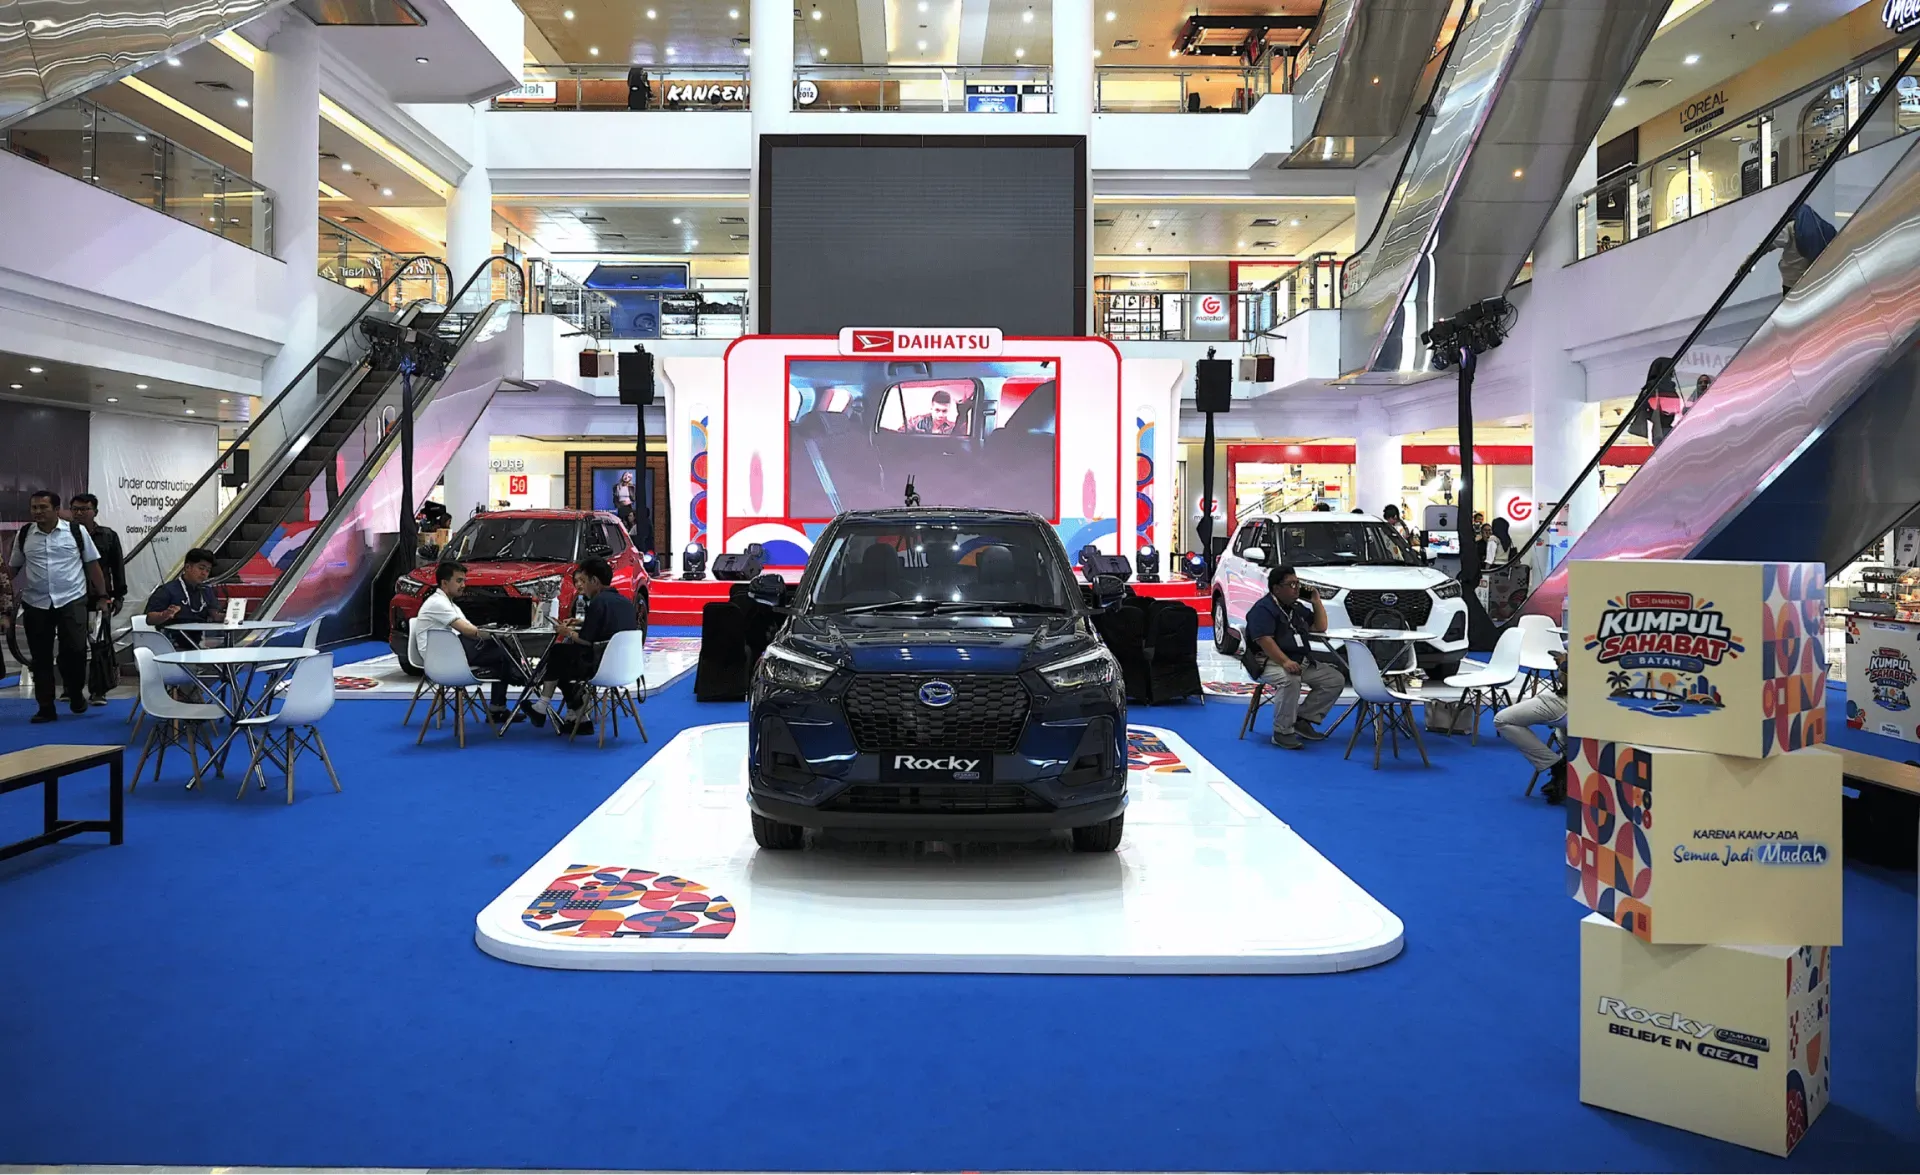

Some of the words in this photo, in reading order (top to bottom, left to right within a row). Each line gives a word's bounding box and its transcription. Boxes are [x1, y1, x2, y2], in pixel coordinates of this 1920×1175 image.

[1680, 90, 1728, 124] L'ORÉAL
[1694, 121, 1713, 134] PARIS
[898, 335, 990, 349] DAIHATSU
[118, 477, 144, 489] Under
[145, 480, 194, 491] construction
[512, 478, 526, 492] 50
[131, 495, 164, 510] Opening
[1600, 611, 1728, 638] KUMPUL
[1601, 633, 1728, 662] SAHABAT
[1638, 656, 1682, 667] BATAM
[1870, 657, 1911, 673] KUMPUL
[1871, 668, 1912, 685] SAHABAT
[894, 755, 980, 772] Rocky
[1693, 830, 1736, 839] KARENA
[1776, 831, 1799, 840] ADA
[1673, 845, 1720, 863] Semua
[1722, 845, 1753, 866] Jadi
[1760, 842, 1824, 863] Mudah
[1598, 996, 1716, 1039] Rocky
[1609, 1023, 1672, 1047] BELIEVE
[1676, 1038, 1692, 1052] IN
[1702, 1045, 1756, 1067] REAL
